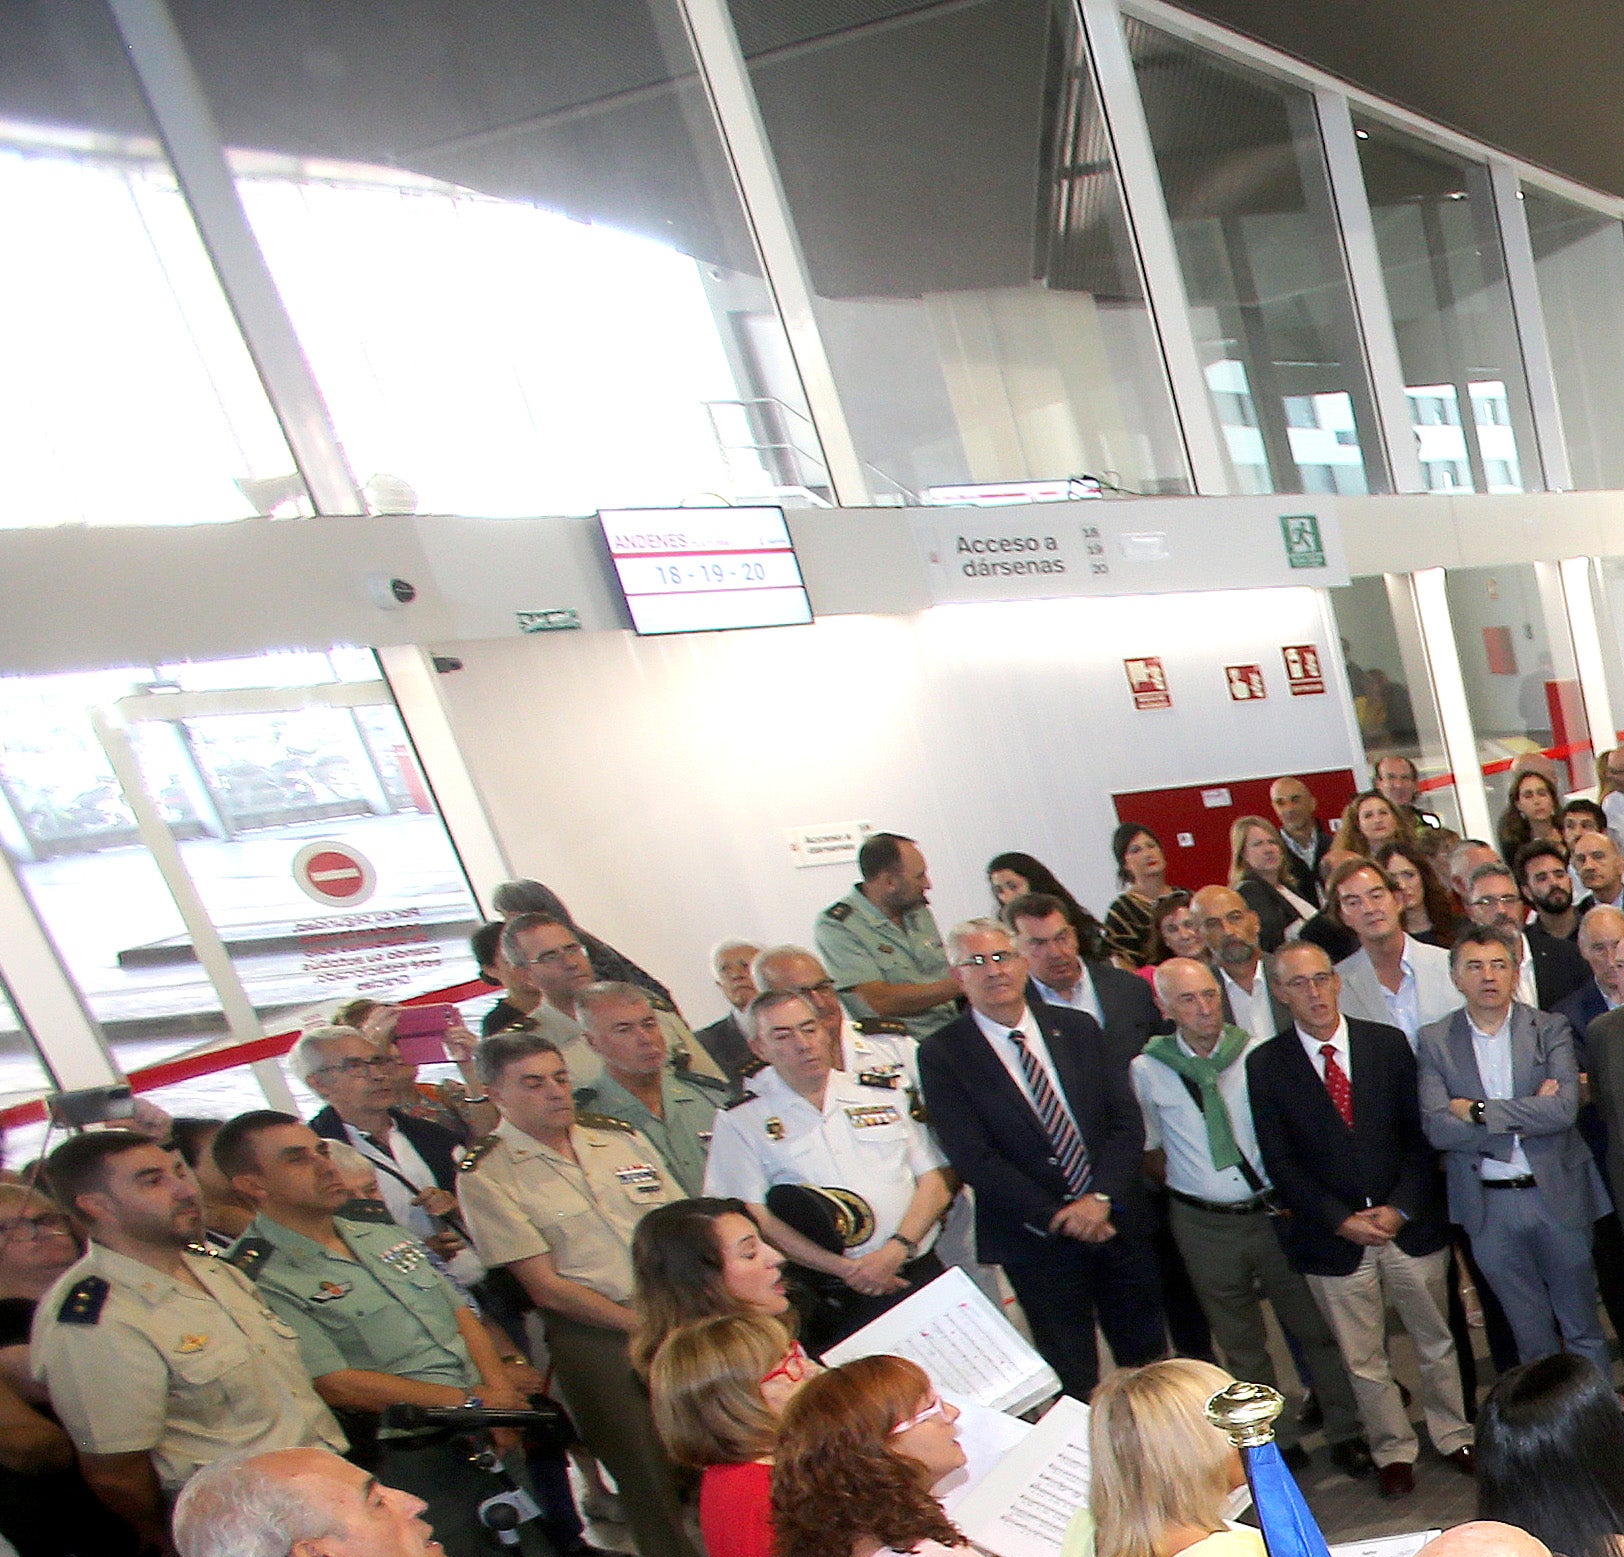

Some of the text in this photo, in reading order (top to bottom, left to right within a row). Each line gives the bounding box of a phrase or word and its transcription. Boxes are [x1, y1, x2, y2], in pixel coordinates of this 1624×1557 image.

[957, 535, 1058, 555] Acceso a
[656, 565, 683, 584] 18
[700, 564, 724, 583] 19
[741, 562, 766, 581] 20
[963, 557, 1065, 578] dársenas
